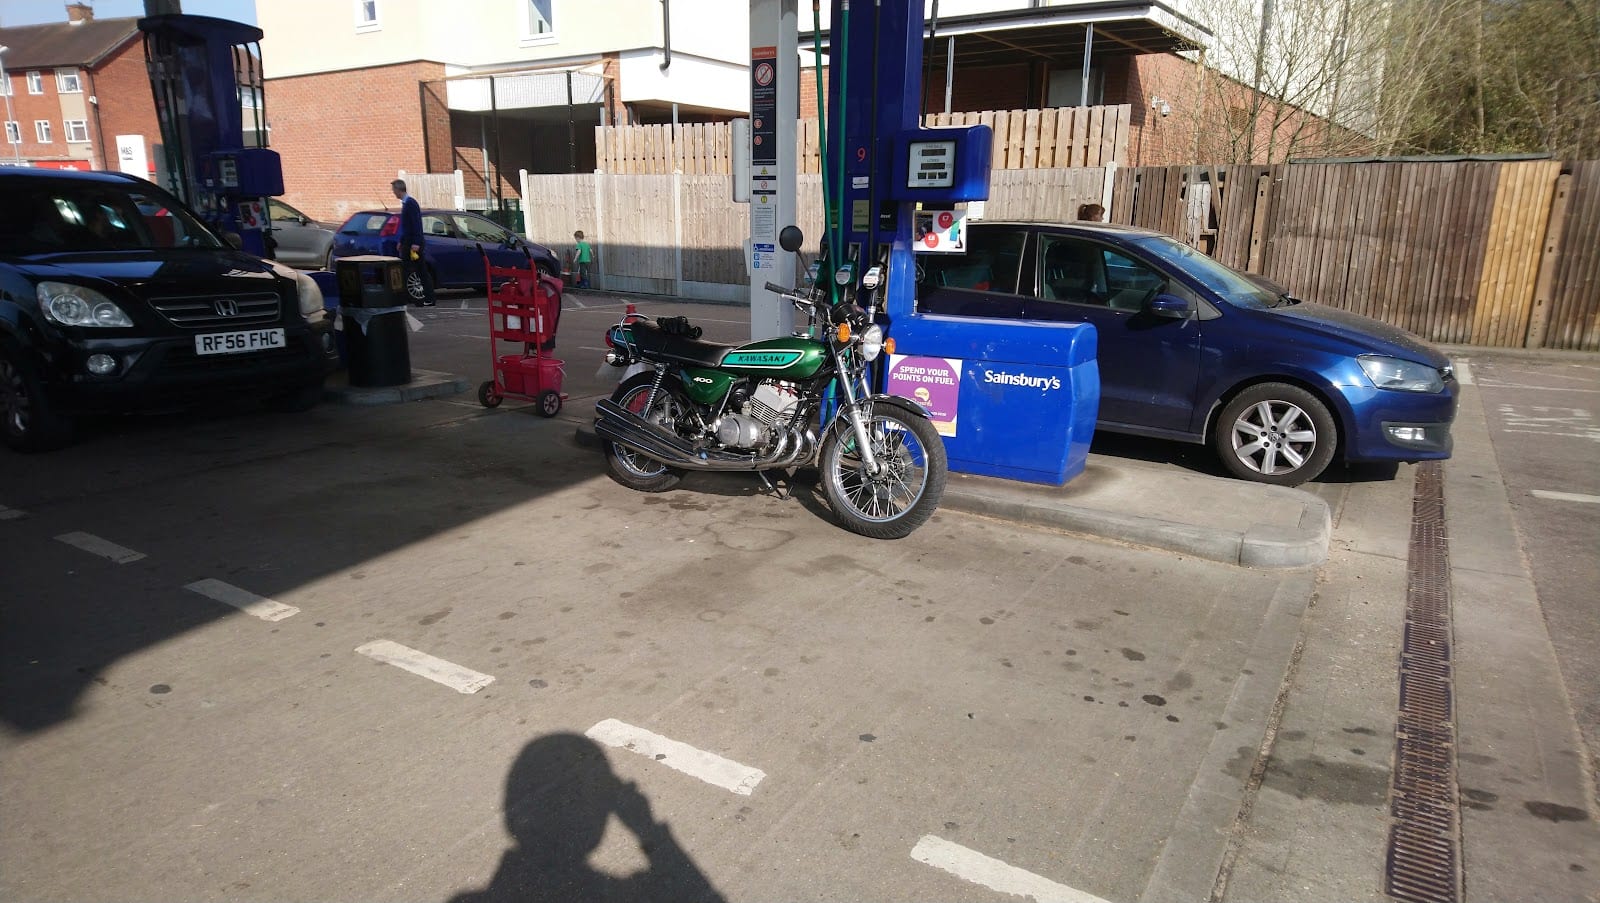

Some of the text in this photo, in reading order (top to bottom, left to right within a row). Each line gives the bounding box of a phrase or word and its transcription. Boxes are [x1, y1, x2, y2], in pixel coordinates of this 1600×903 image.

[857, 147, 866, 162] 9
[203, 331, 279, 351] RF56 FHC
[899, 366, 949, 377] SPEND YOUR
[693, 376, 713, 384] 400
[892, 373, 955, 385] POINTS ON FUEL
[984, 370, 1061, 391] Sainsbury's
